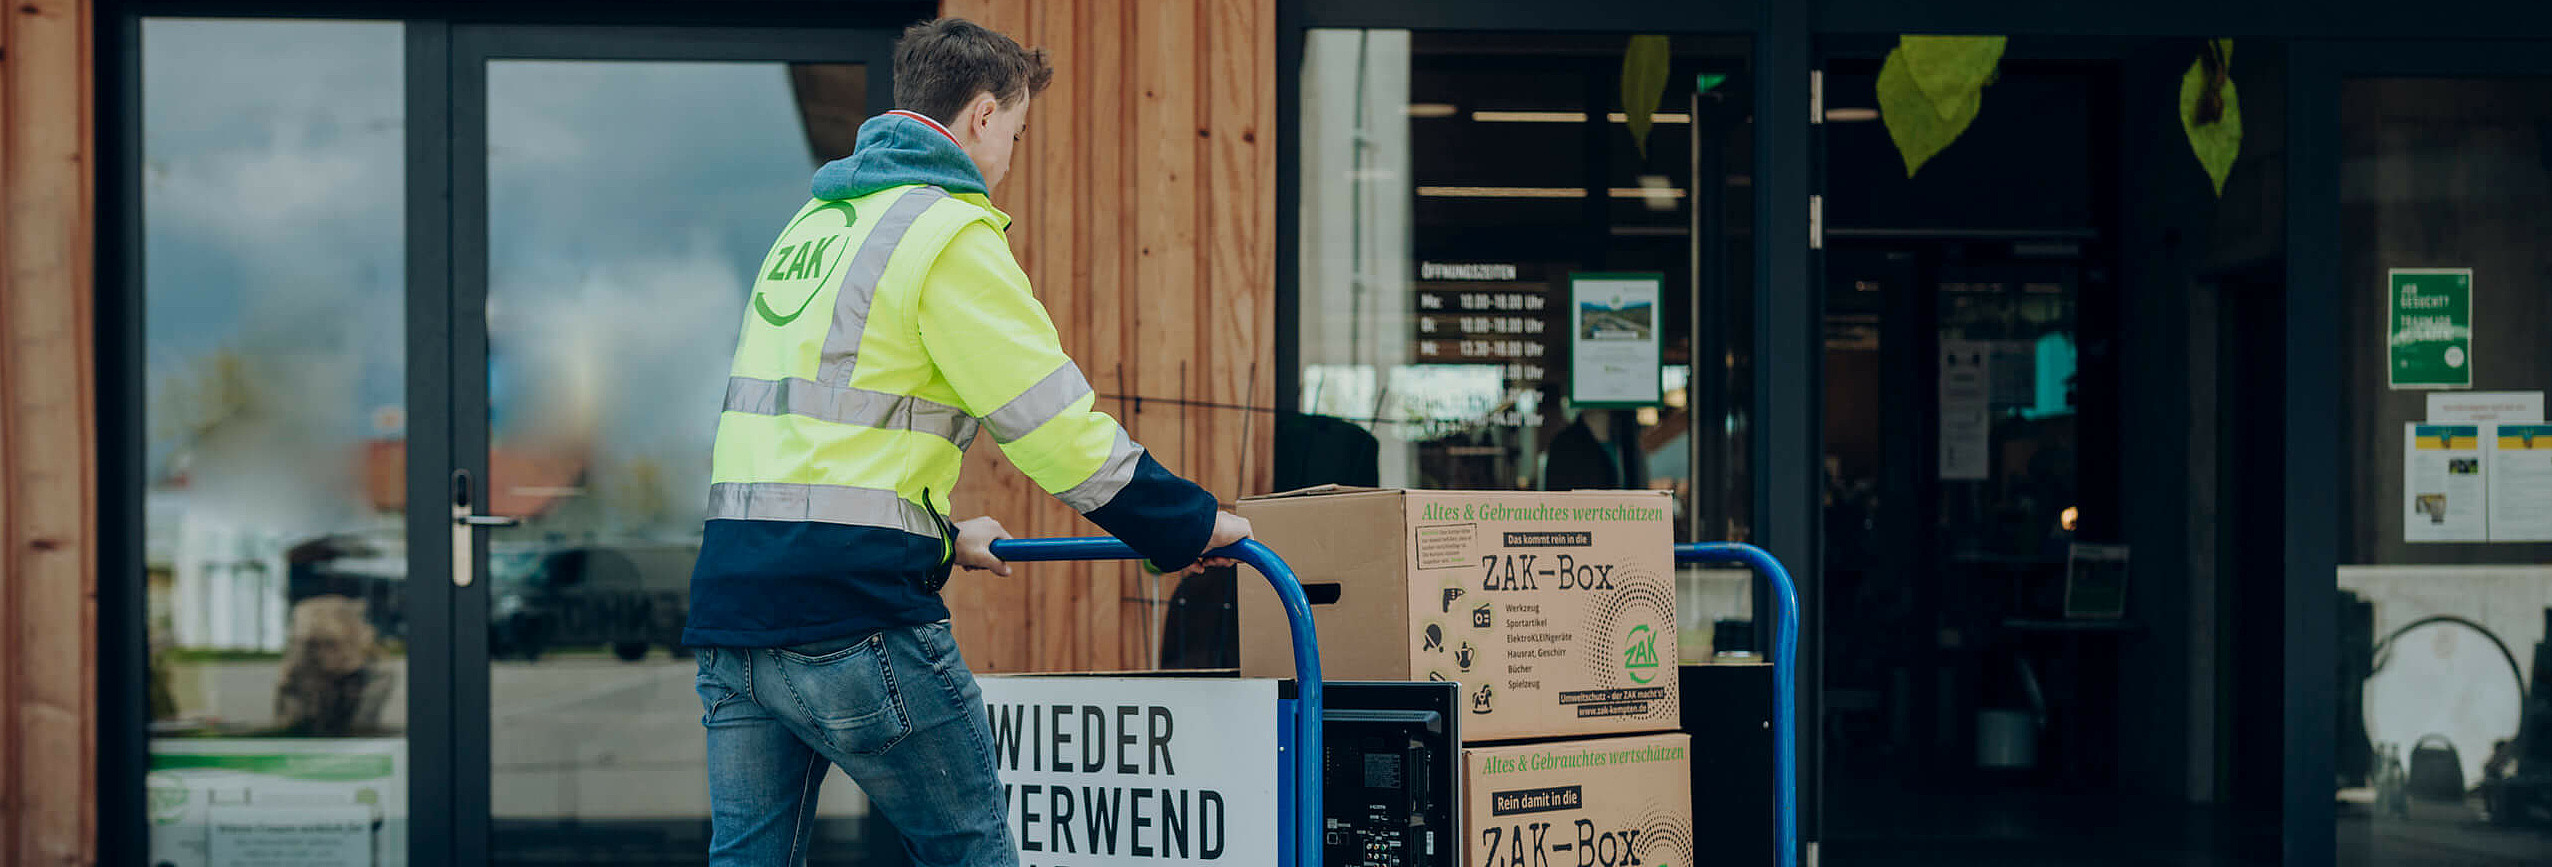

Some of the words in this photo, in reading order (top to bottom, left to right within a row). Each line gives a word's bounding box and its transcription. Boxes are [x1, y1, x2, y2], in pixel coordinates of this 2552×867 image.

[767, 235, 839, 280] ZAK
[1524, 294, 1544, 309] Uhr
[1524, 318, 1544, 333] Uhr
[1524, 342, 1544, 357] Uhr
[1422, 502, 1459, 520] Altes
[1463, 503, 1474, 520] &
[1479, 503, 1569, 521] Gebrauchtes
[1572, 504, 1662, 522] wertschätzen
[1508, 535, 1522, 544] Das
[1523, 534, 1550, 544] kommt
[1551, 534, 1566, 544] rein
[1567, 534, 1575, 544] in
[1576, 534, 1587, 544] die
[1482, 554, 1614, 591] ZAK-Box
[1505, 604, 1540, 614] Werkzeug
[1506, 619, 1548, 629] Sportartikel
[1537, 648, 1566, 657] Geschirr
[1624, 629, 1658, 668] ZAK
[1508, 665, 1532, 674] Bücher
[1508, 680, 1540, 691] Spielzeug
[1624, 691, 1637, 699] ZAK
[987, 704, 1175, 775] WIEDER
[1482, 755, 1515, 774] Altes
[1517, 755, 1528, 771] &
[1531, 750, 1606, 771] Gebrauchtes
[1609, 745, 1685, 764] wertschätzen
[1497, 795, 1519, 811] Rein
[1522, 793, 1550, 809] damit
[1551, 791, 1562, 805] in
[1563, 790, 1578, 804] die
[1482, 818, 1641, 867] ZAK-Box
